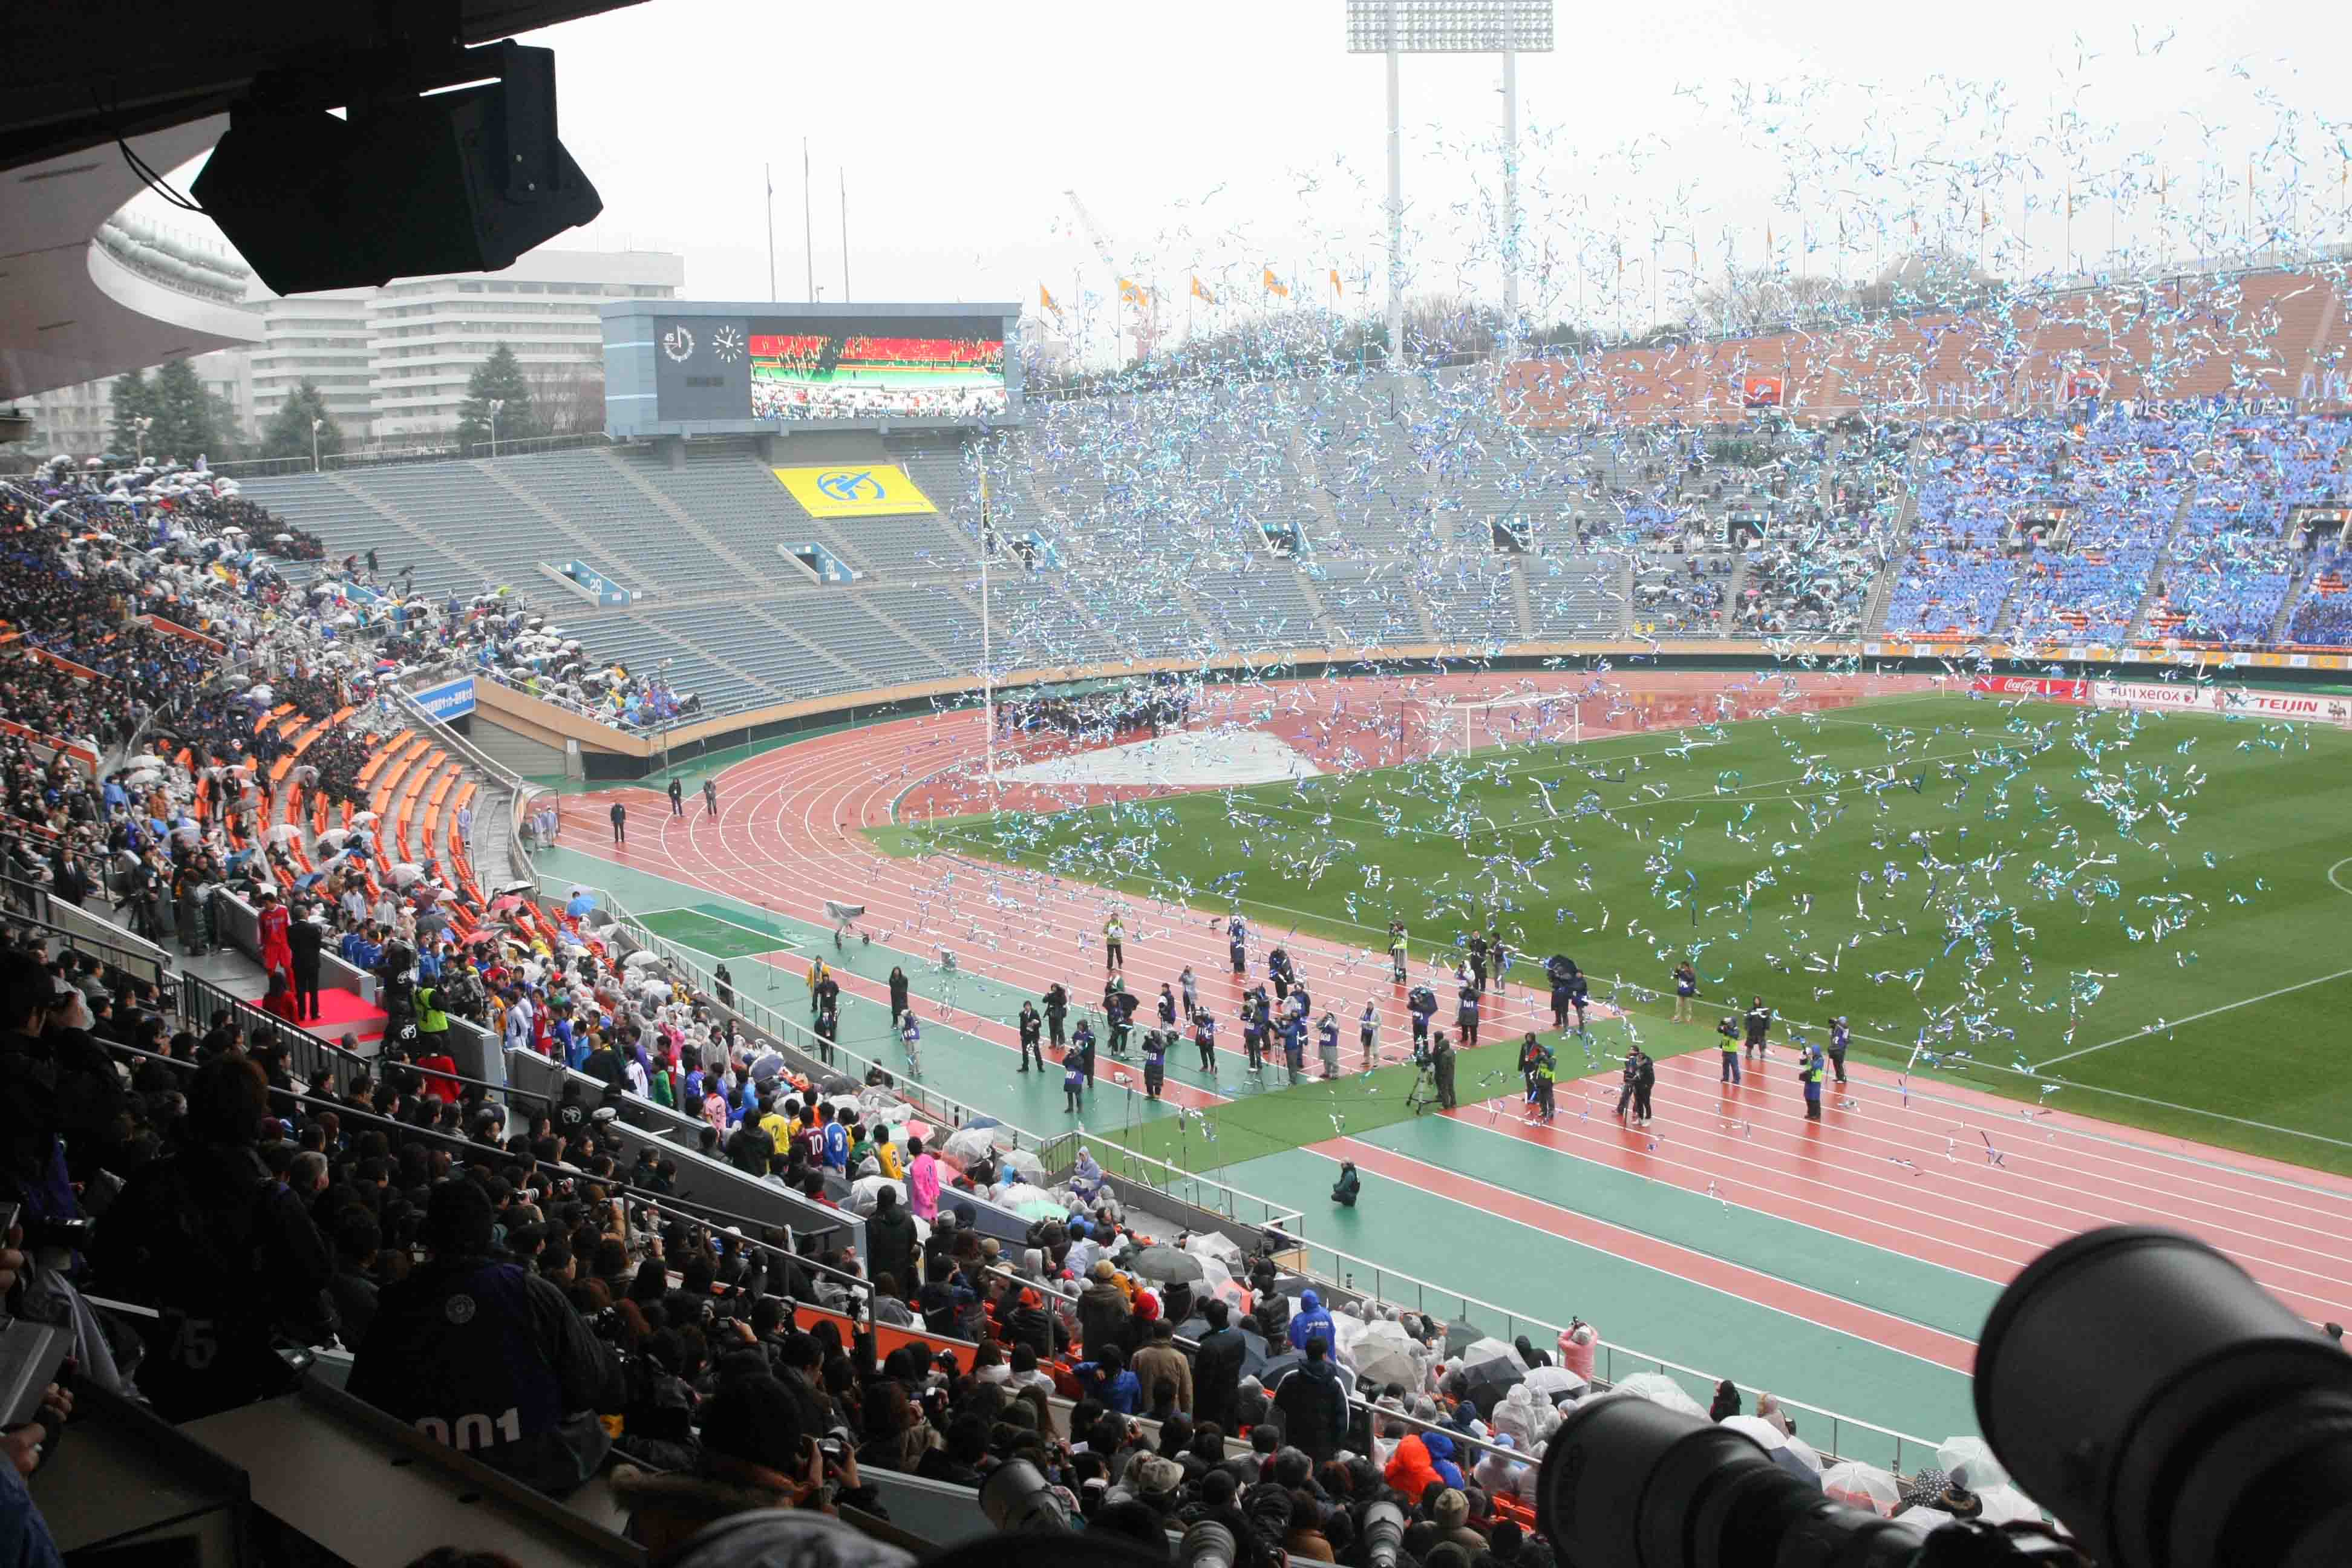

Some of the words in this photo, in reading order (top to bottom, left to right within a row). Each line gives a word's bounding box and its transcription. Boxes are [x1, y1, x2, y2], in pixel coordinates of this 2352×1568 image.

[665, 333, 675, 341] 45
[2139, 688, 2180, 701] xerox
[2259, 698, 2318, 713] TEIJIN
[809, 1134, 823, 1155] 10
[834, 1132, 843, 1152] 3
